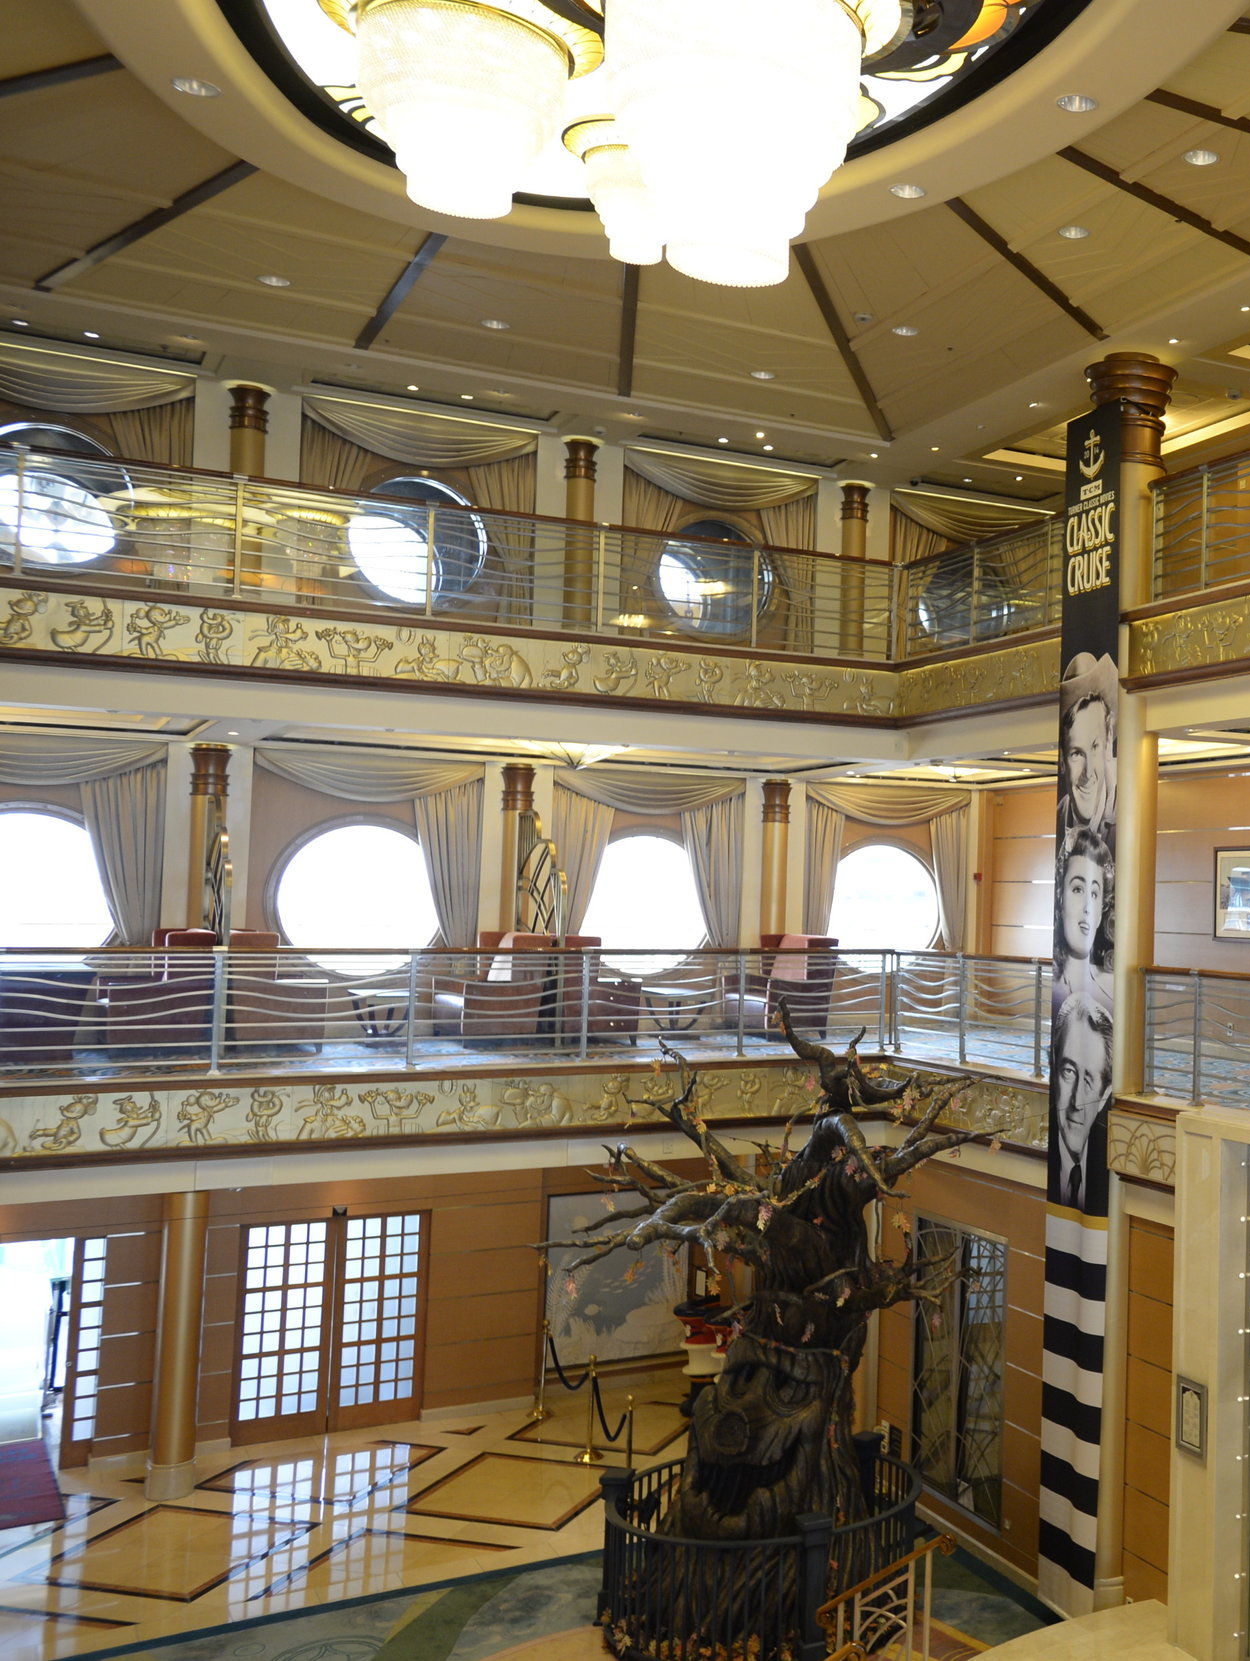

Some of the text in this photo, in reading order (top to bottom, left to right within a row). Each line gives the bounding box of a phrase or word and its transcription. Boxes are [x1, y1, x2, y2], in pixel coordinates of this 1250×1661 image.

[1082, 483, 1101, 496] TCM
[1066, 502, 1115, 555] CLASSIC
[1067, 546, 1112, 596] CRUISE
